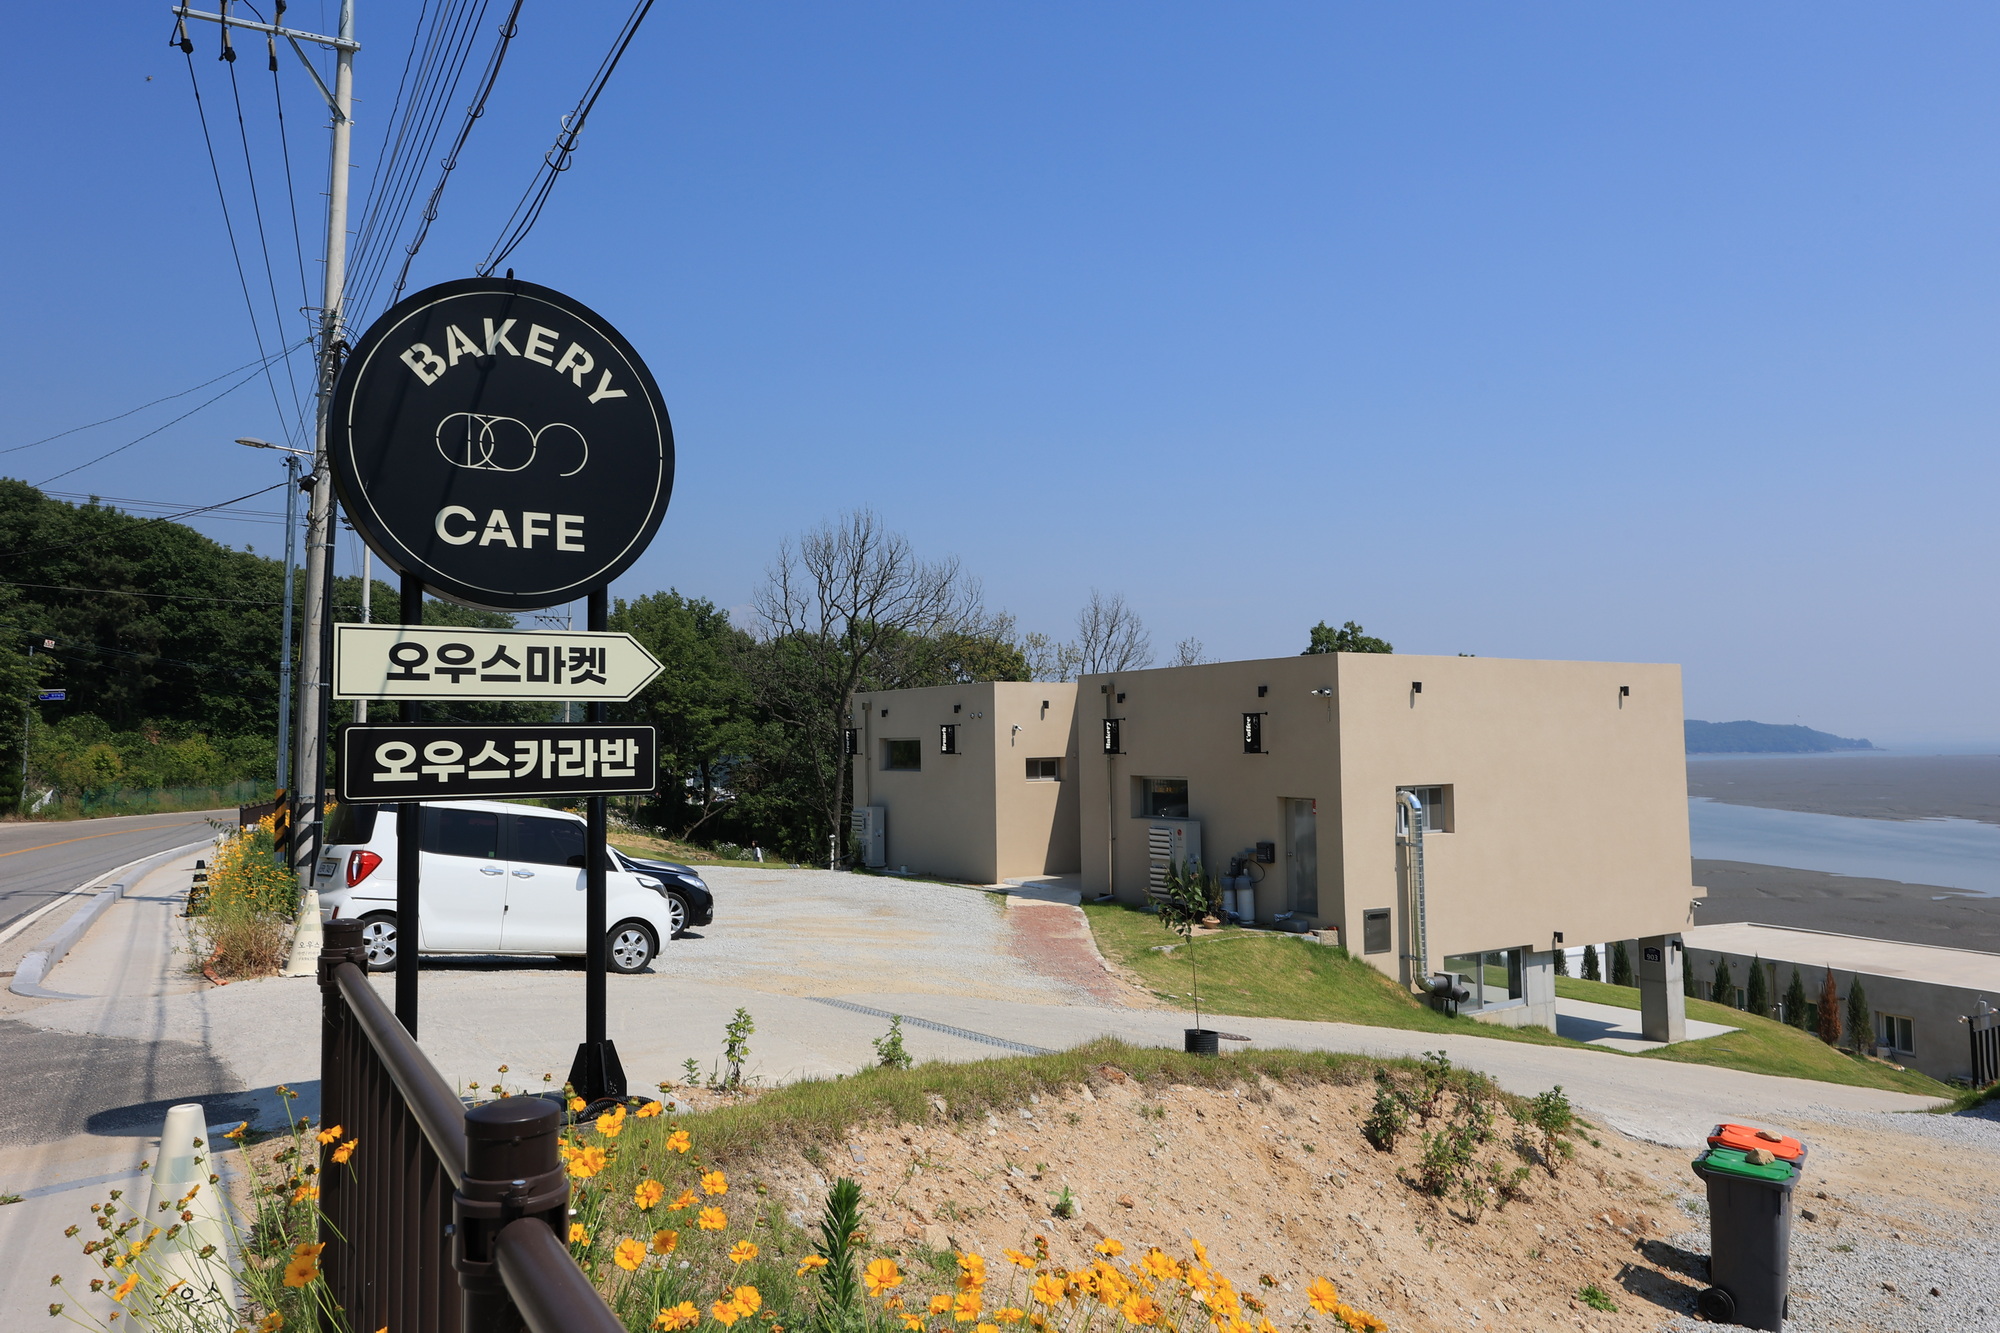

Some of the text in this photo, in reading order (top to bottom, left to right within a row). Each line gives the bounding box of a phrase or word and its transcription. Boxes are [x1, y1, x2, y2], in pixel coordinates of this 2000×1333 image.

[400, 318, 628, 404] BAKERY
[435, 505, 586, 552] CAFE
[386, 641, 608, 686] 오우스마켓
[372, 738, 640, 783] 오우스카라반
[1646, 953, 1658, 961] 903
